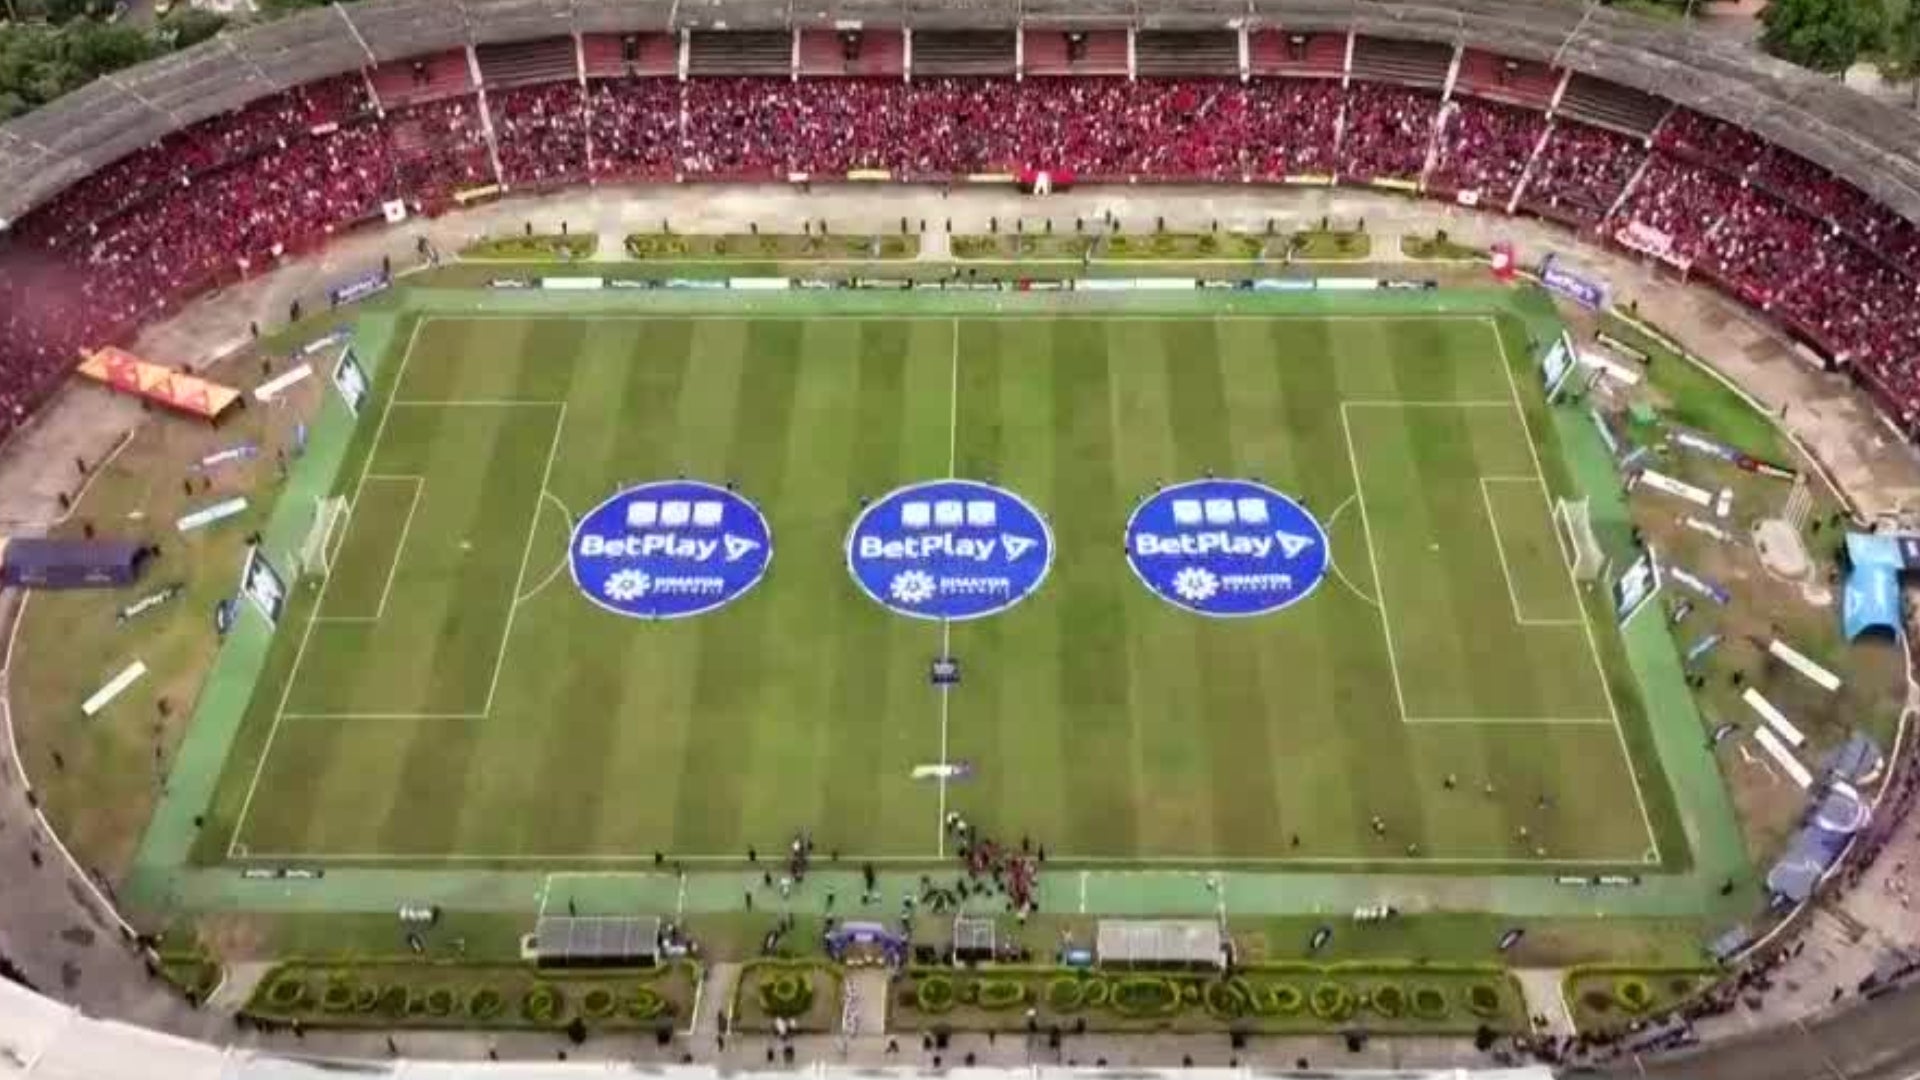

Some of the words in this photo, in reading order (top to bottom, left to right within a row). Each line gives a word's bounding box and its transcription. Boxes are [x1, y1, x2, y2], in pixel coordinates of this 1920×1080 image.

[580, 534, 718, 562] BetPlay
[860, 532, 997, 561] BetPlay
[1136, 531, 1273, 557] BetPlay
